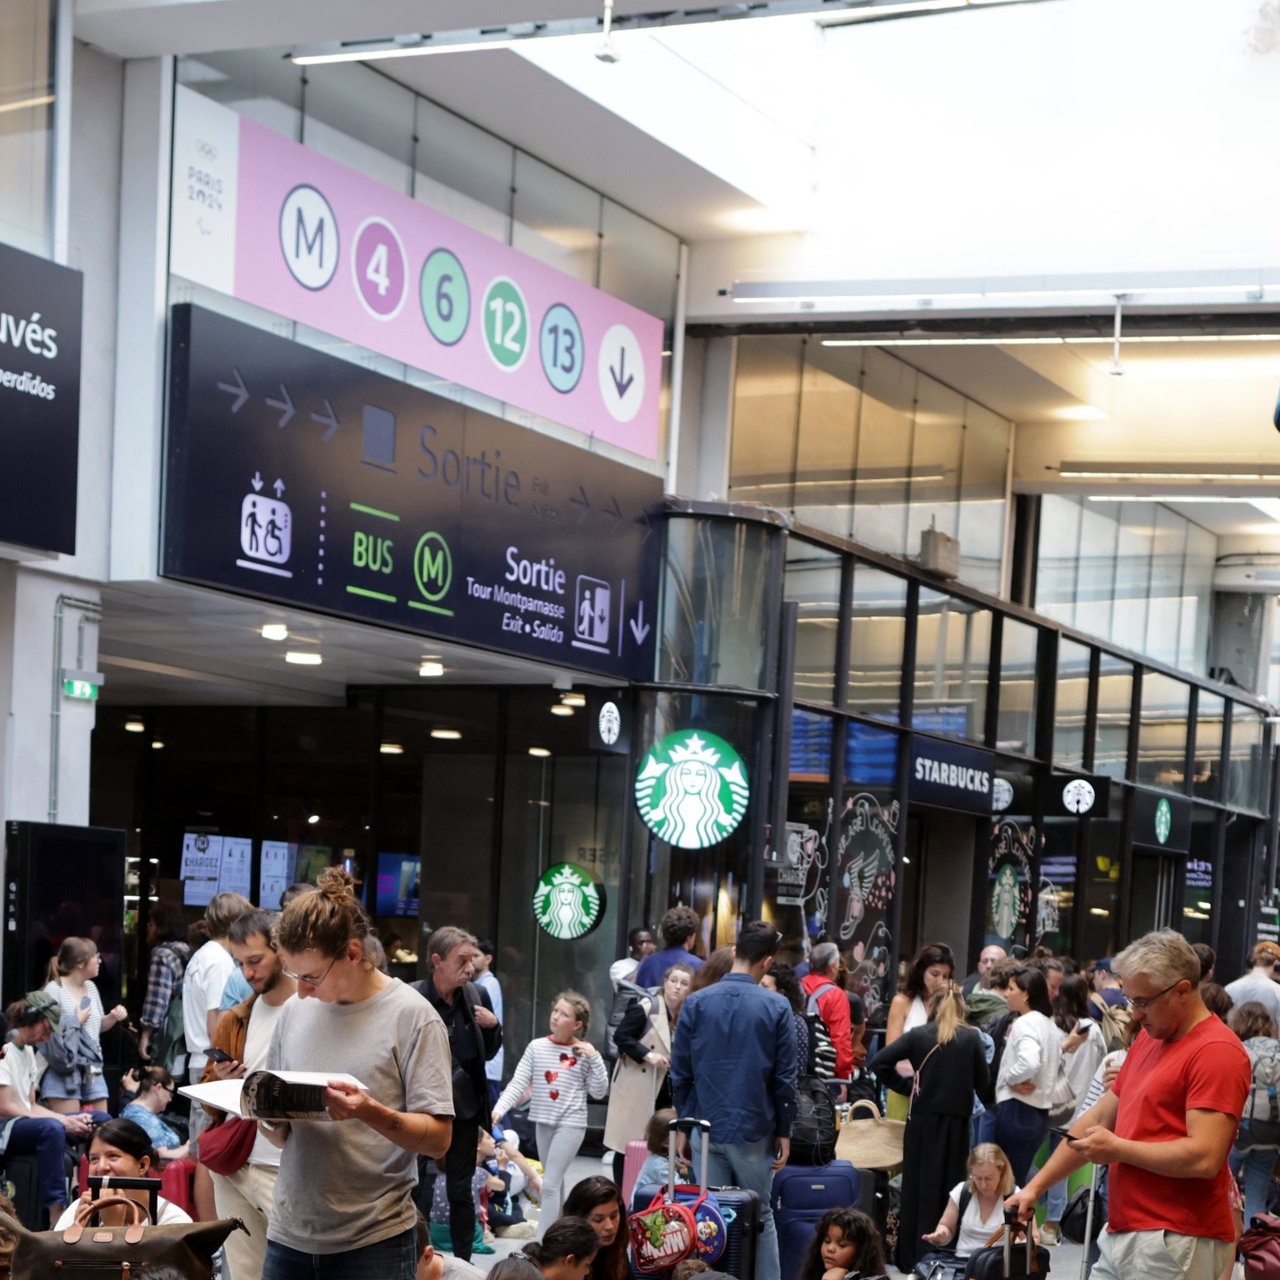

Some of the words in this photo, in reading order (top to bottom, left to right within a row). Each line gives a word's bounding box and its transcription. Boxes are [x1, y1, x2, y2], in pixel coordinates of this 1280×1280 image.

[187, 165, 224, 195] PARIS
[187, 186, 223, 213] 2024
[295, 206, 325, 269] M
[365, 243, 390, 296] 4
[435, 273, 455, 323] 6
[489, 295, 521, 354] 12
[546, 322, 576, 374] 13
[417, 424, 521, 508] Sortie
[352, 530, 394, 575] BUS
[421, 549, 445, 588] M
[505, 545, 567, 595] Sortie
[466, 576, 492, 602] Tour
[492, 586, 565, 620] Montparnasse
[501, 612, 524, 635] Exit
[531, 620, 564, 644] Salida
[914, 757, 990, 793] STARBUCKS
